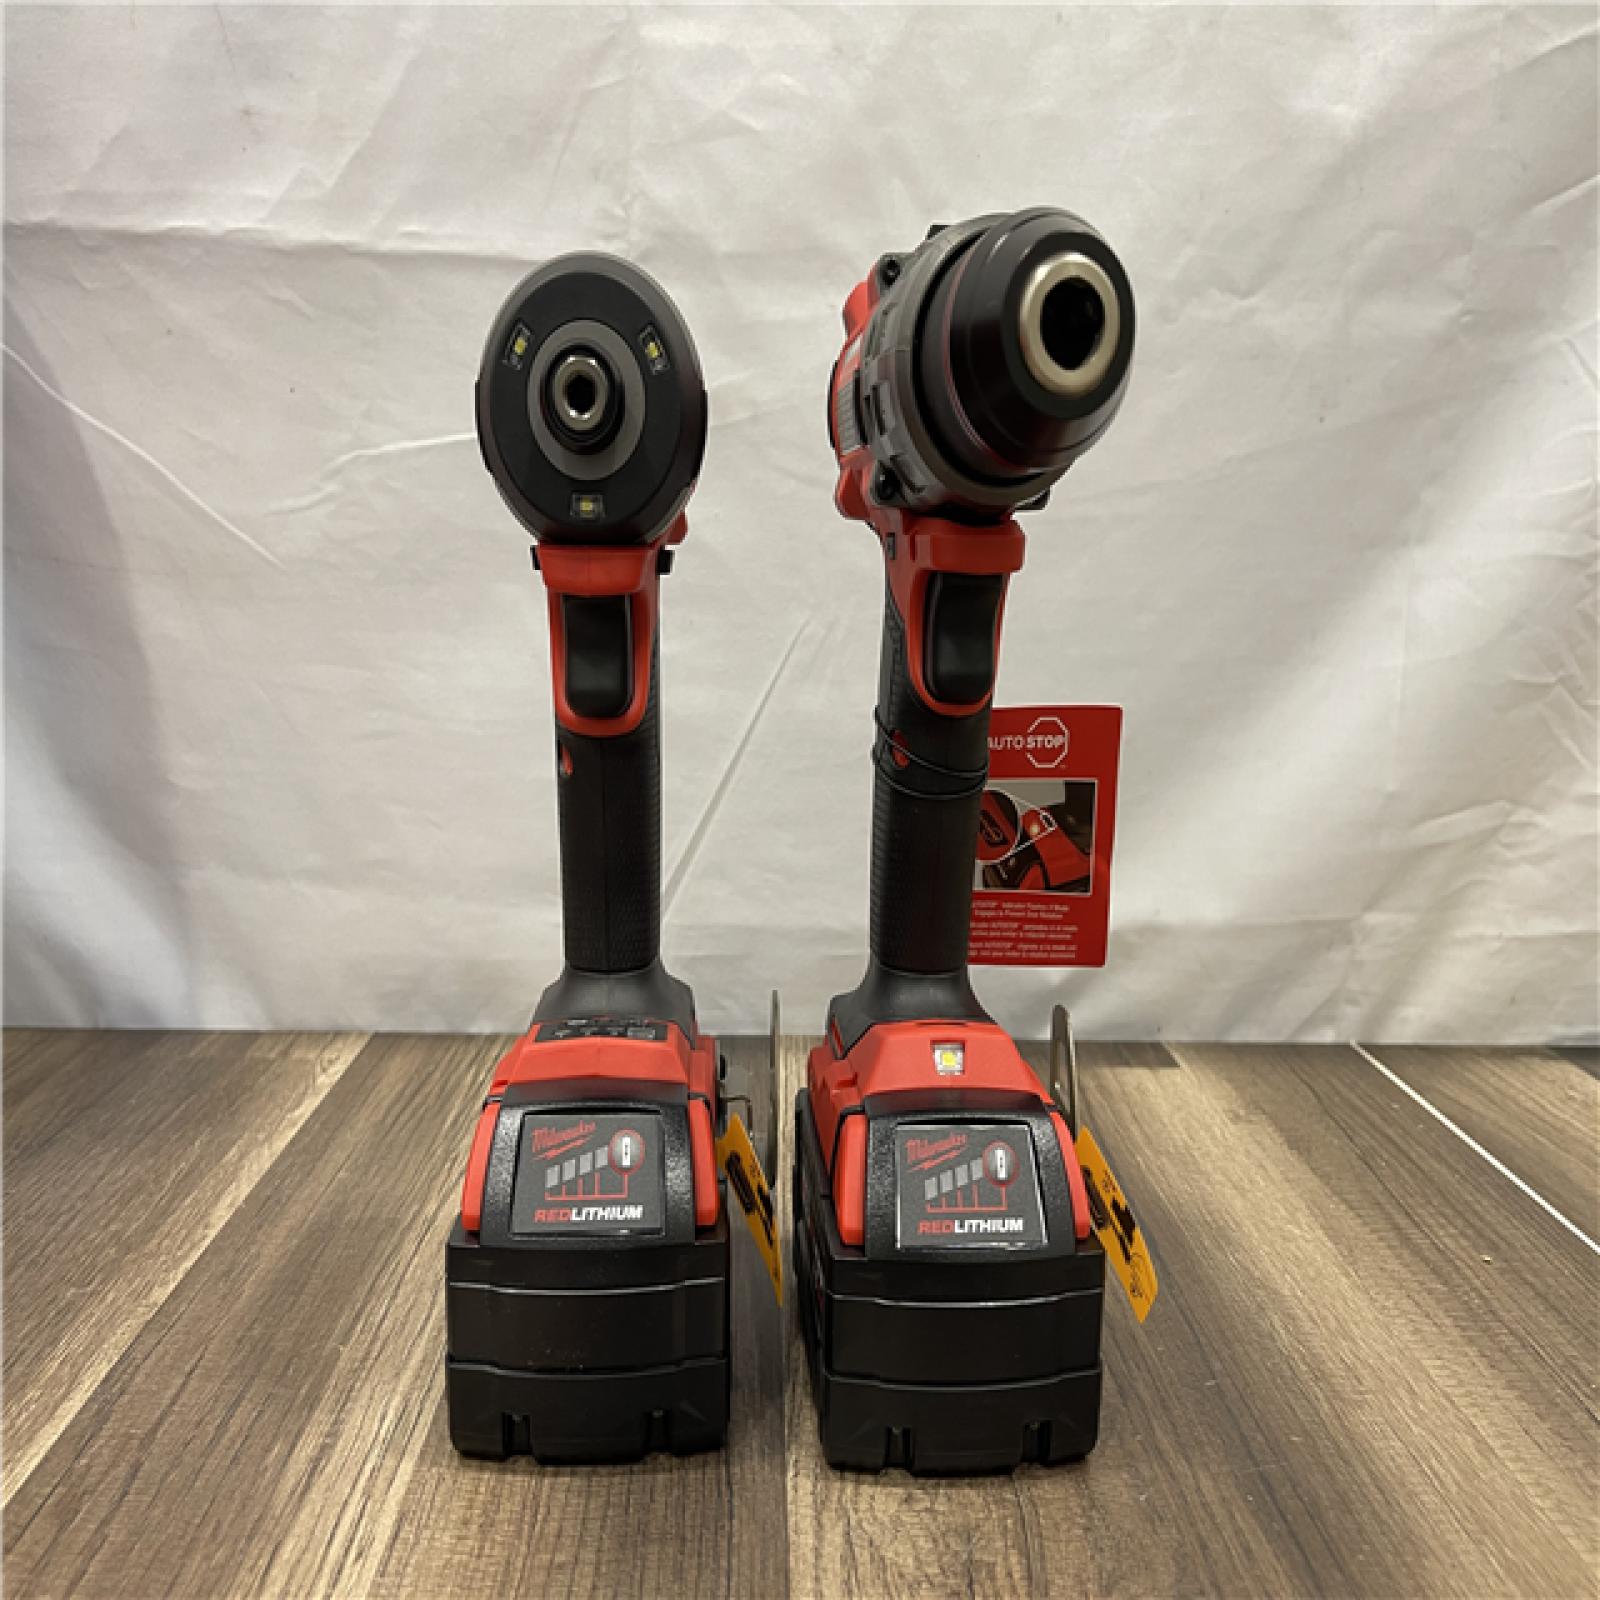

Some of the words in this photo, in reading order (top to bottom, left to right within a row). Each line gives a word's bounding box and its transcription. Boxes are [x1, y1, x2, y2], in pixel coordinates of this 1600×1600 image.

[1026, 734, 1065, 749] STOP
[534, 1204, 643, 1223] REDLITHIUM
[917, 1217, 1024, 1235] REDLITHIUM
